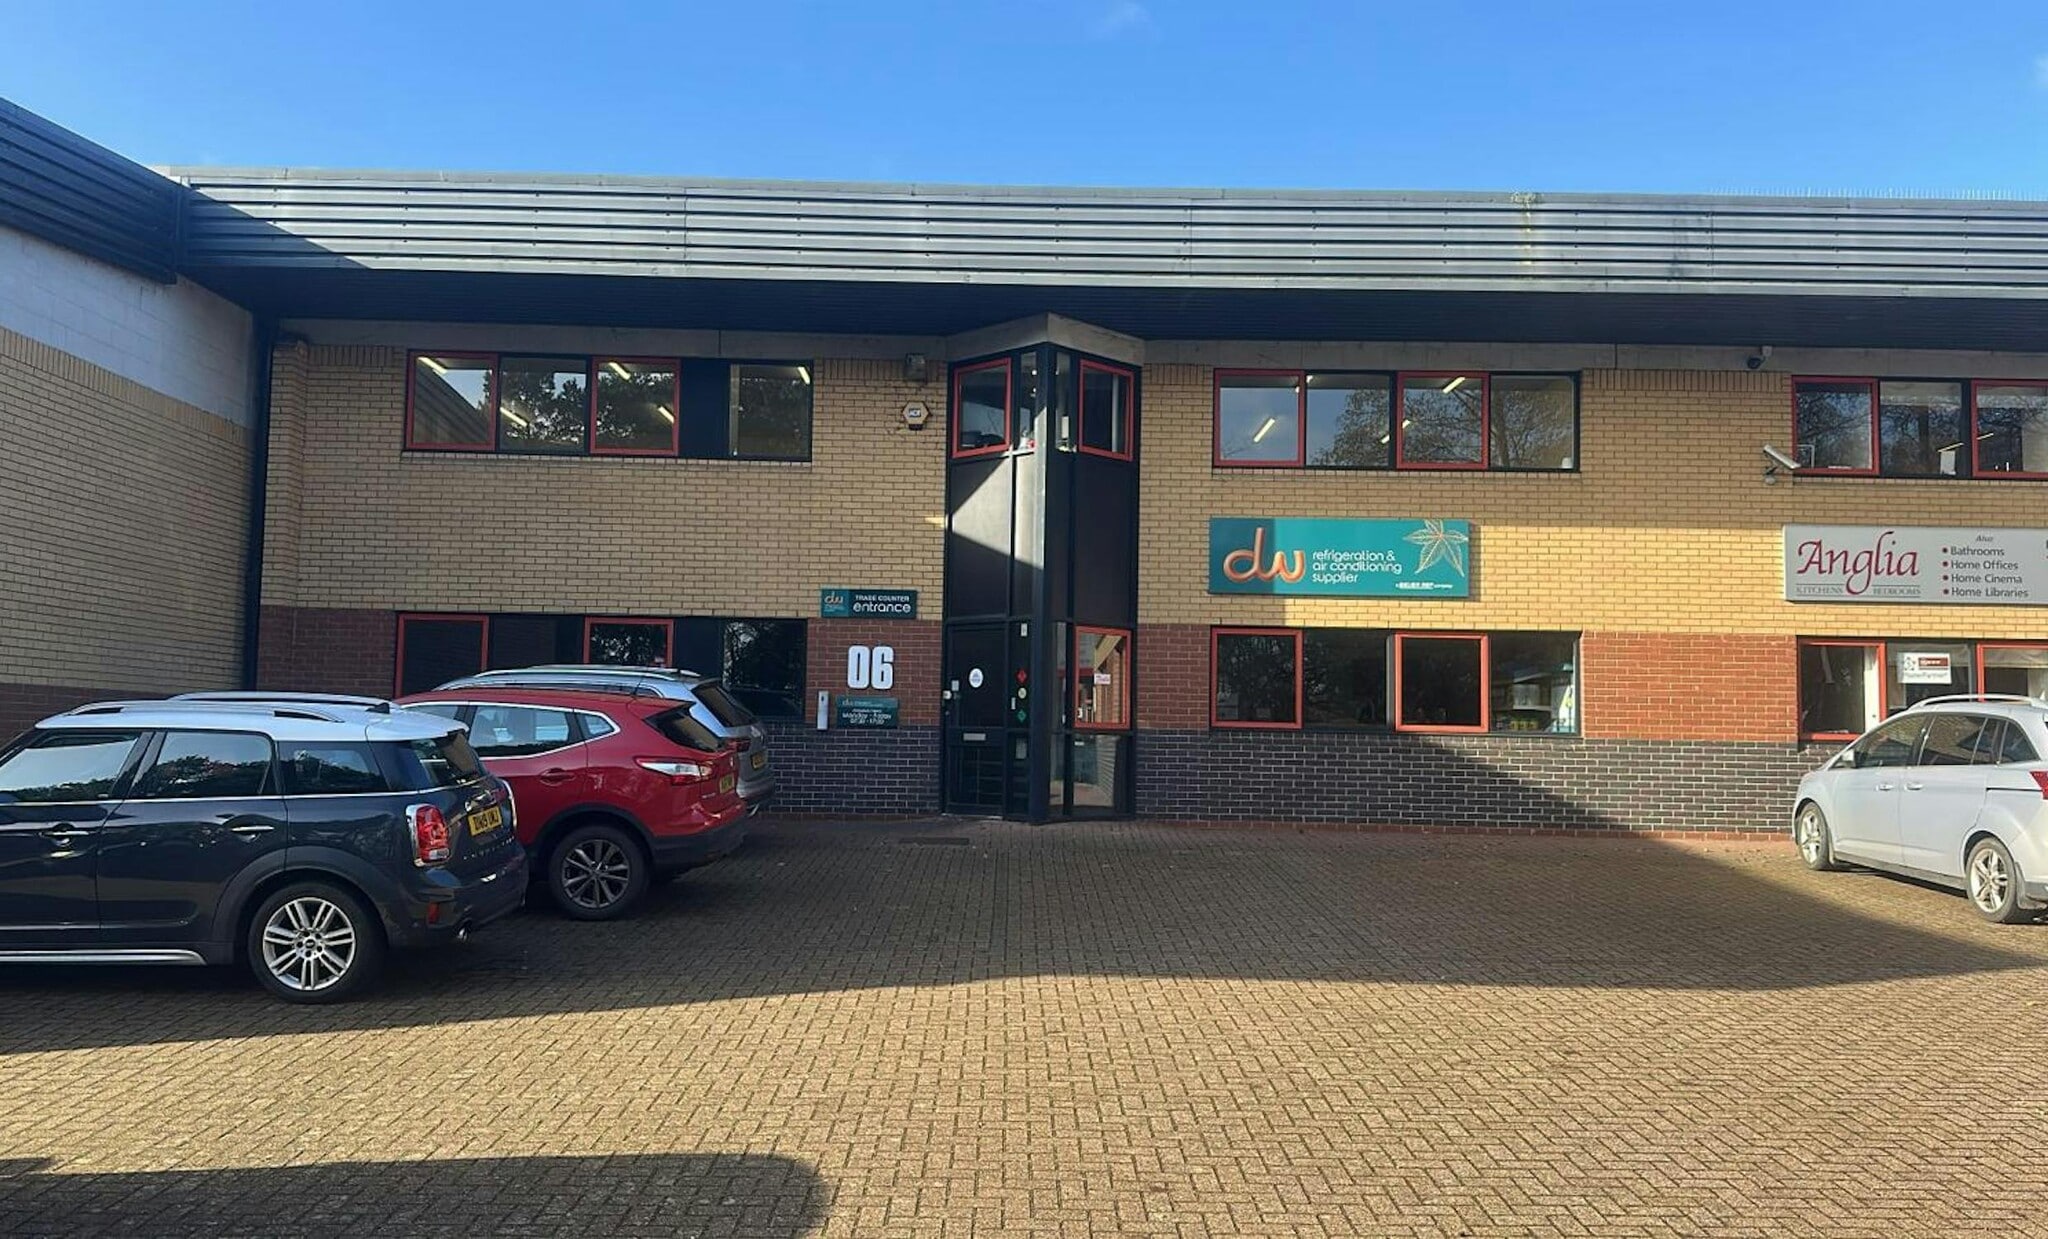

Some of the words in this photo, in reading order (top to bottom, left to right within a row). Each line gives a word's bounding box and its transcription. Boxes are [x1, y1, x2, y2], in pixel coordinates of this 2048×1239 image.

[1312, 549, 1384, 562] refrigeration
[1386, 550, 1396, 561] &
[1950, 546, 2005, 556] Bathrooms
[1312, 561, 1328, 571] air
[1330, 561, 1402, 575] conditioning
[1797, 531, 1919, 595] Anglia
[1951, 560, 1981, 570] Home
[1983, 560, 2019, 570] Offices
[1312, 572, 1358, 584] supplier
[1951, 573, 1982, 583] Home
[1984, 574, 2023, 584] Cinema
[1951, 587, 1982, 597] Home
[1985, 587, 2029, 598] Libraries
[853, 602, 911, 613] entrance
[847, 645, 894, 689] 06
